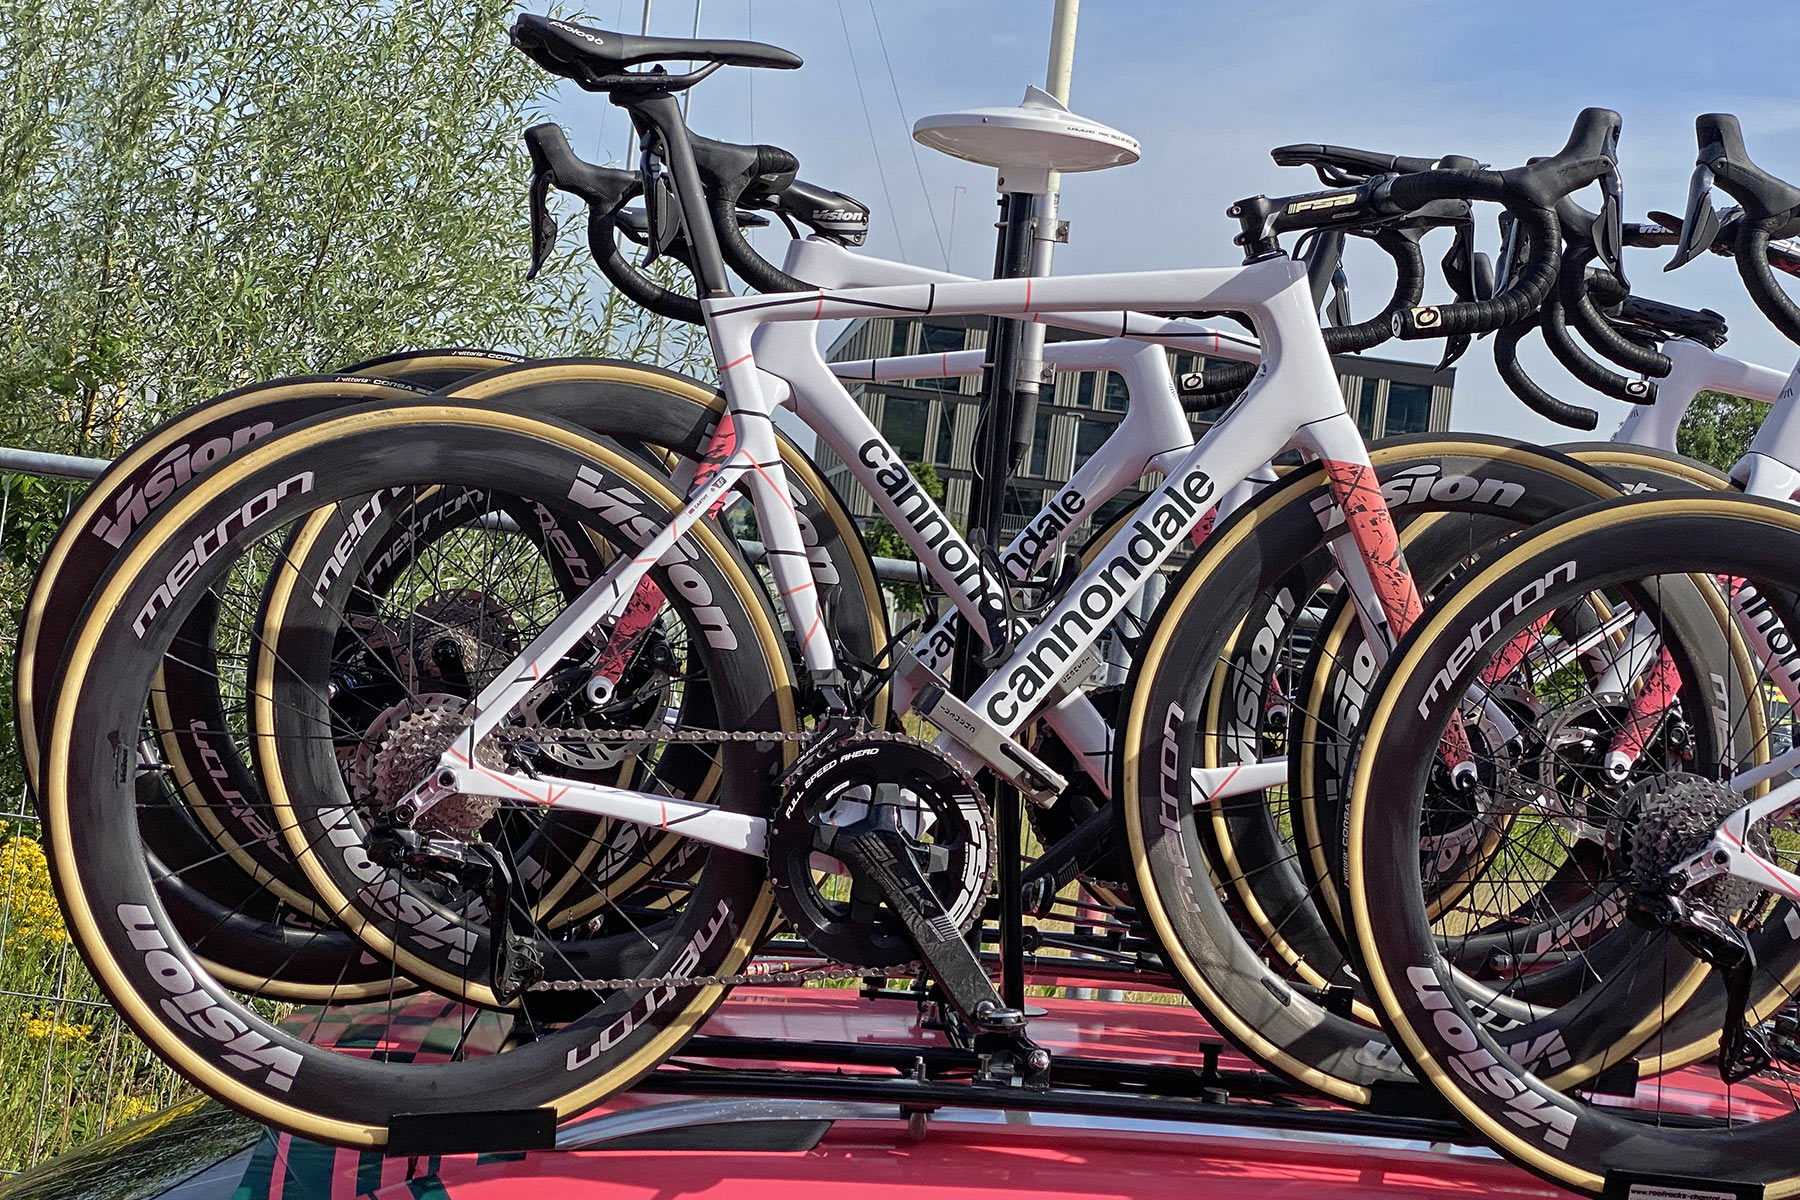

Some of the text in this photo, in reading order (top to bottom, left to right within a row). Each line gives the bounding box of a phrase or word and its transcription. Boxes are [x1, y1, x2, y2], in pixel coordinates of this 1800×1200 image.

[549, 21, 604, 45] prologo
[812, 208, 864, 221] Vision
[372, 378, 414, 391] CORSA
[487, 353, 525, 364] CORSA
[92, 421, 274, 549] Vision
[131, 470, 315, 640] metron
[312, 488, 406, 609] metr
[986, 470, 1215, 728] cannondale
[1417, 559, 1577, 720] metron
[785, 748, 880, 819] FULL SPEED AHEAD
[1159, 700, 1202, 914] metron
[1342, 803, 1351, 847] CORSA
[316, 807, 479, 967] Vision
[116, 903, 305, 1092] Vision
[566, 900, 730, 1072] metron
[1406, 966, 1578, 1150] Vision
